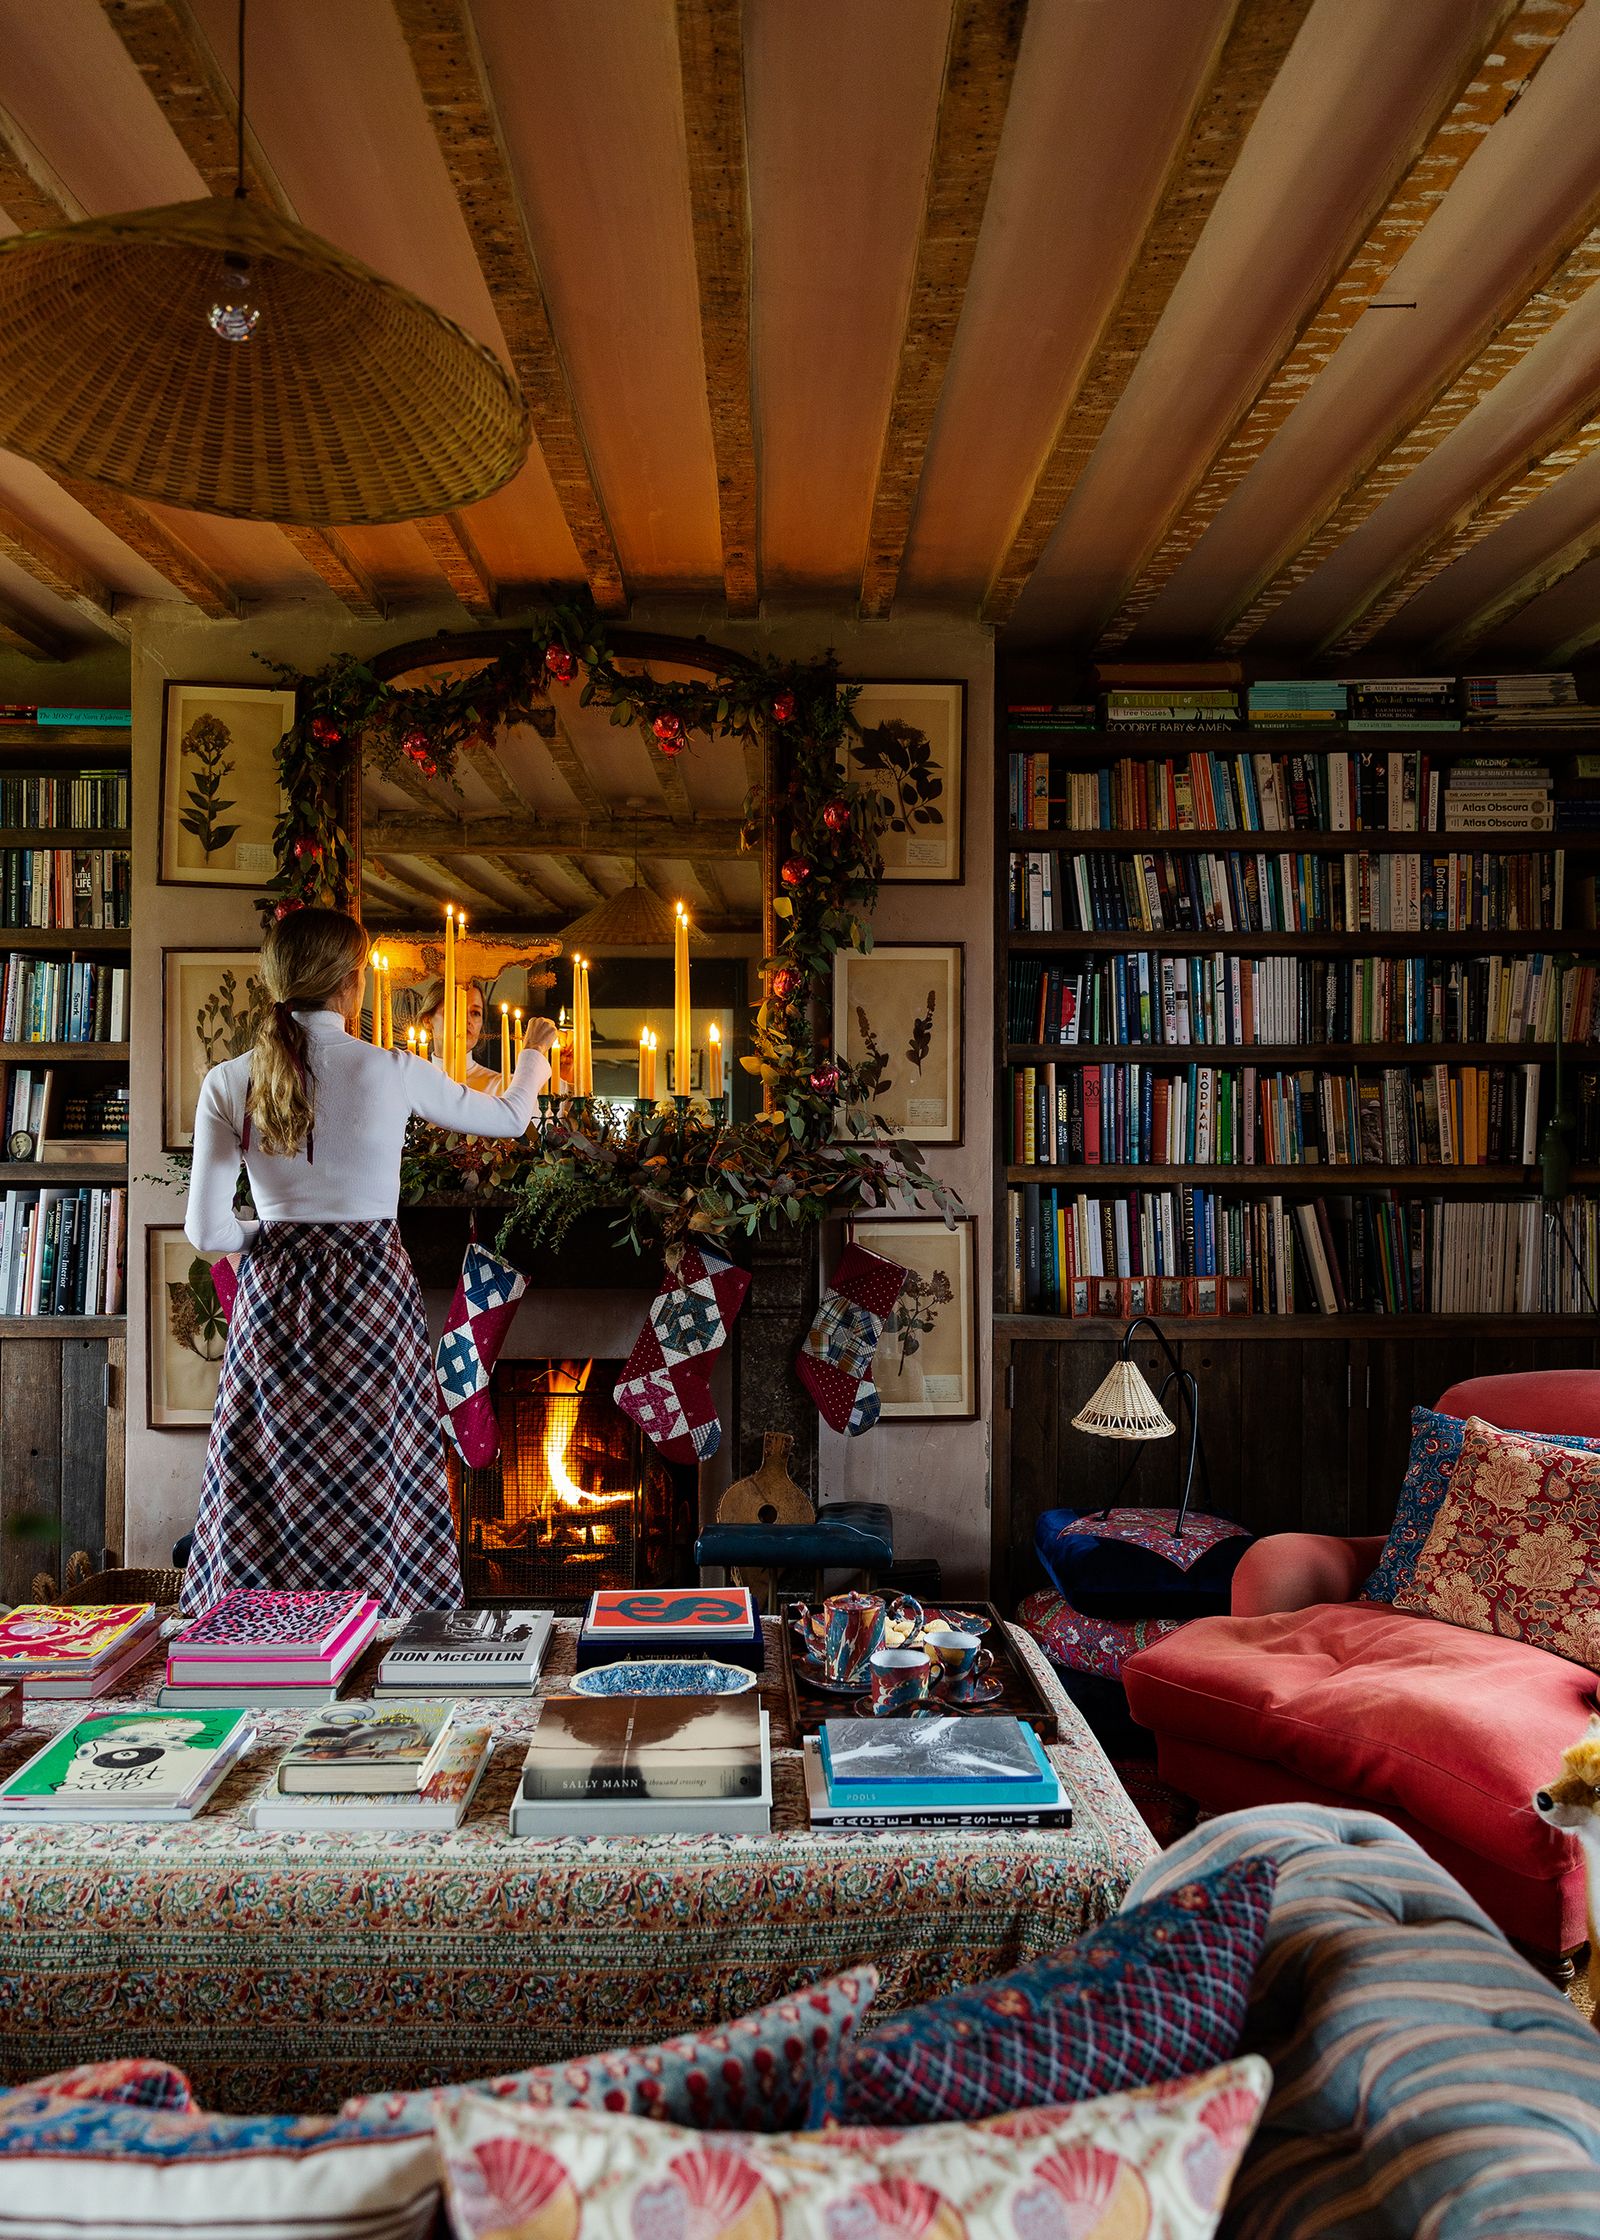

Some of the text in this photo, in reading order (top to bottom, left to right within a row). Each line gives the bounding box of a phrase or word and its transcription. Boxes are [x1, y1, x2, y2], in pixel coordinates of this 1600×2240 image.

[1106, 720, 1157, 732] GOODBYE
[1159, 720, 1185, 732] BABY
[1197, 720, 1232, 732] AMEN
[1475, 759, 1509, 767] WILDING
[1462, 803, 1529, 812] Atlas Obscura
[1462, 819, 1528, 827] Atlas Obscura
[75, 879, 91, 888] LIFE
[1436, 867, 1446, 911] OxCrimes
[1146, 876, 1157, 910] PAKISTAN
[1165, 992, 1175, 1016] TIGER
[1199, 1072, 1209, 1131] RODHAM
[1104, 1207, 1112, 1229] BOOK
[1184, 1189, 1194, 1244] LOULOU
[60, 1220, 72, 1288] The Iconic Interior
[1106, 1240, 1114, 1270] BRITISH
[389, 1651, 525, 1662] DON McCULLIN
[562, 1778, 599, 1789] SALLY
[602, 1777, 639, 1788] MANN
[832, 1814, 1040, 1827] RACHEL FEINSTEIN
